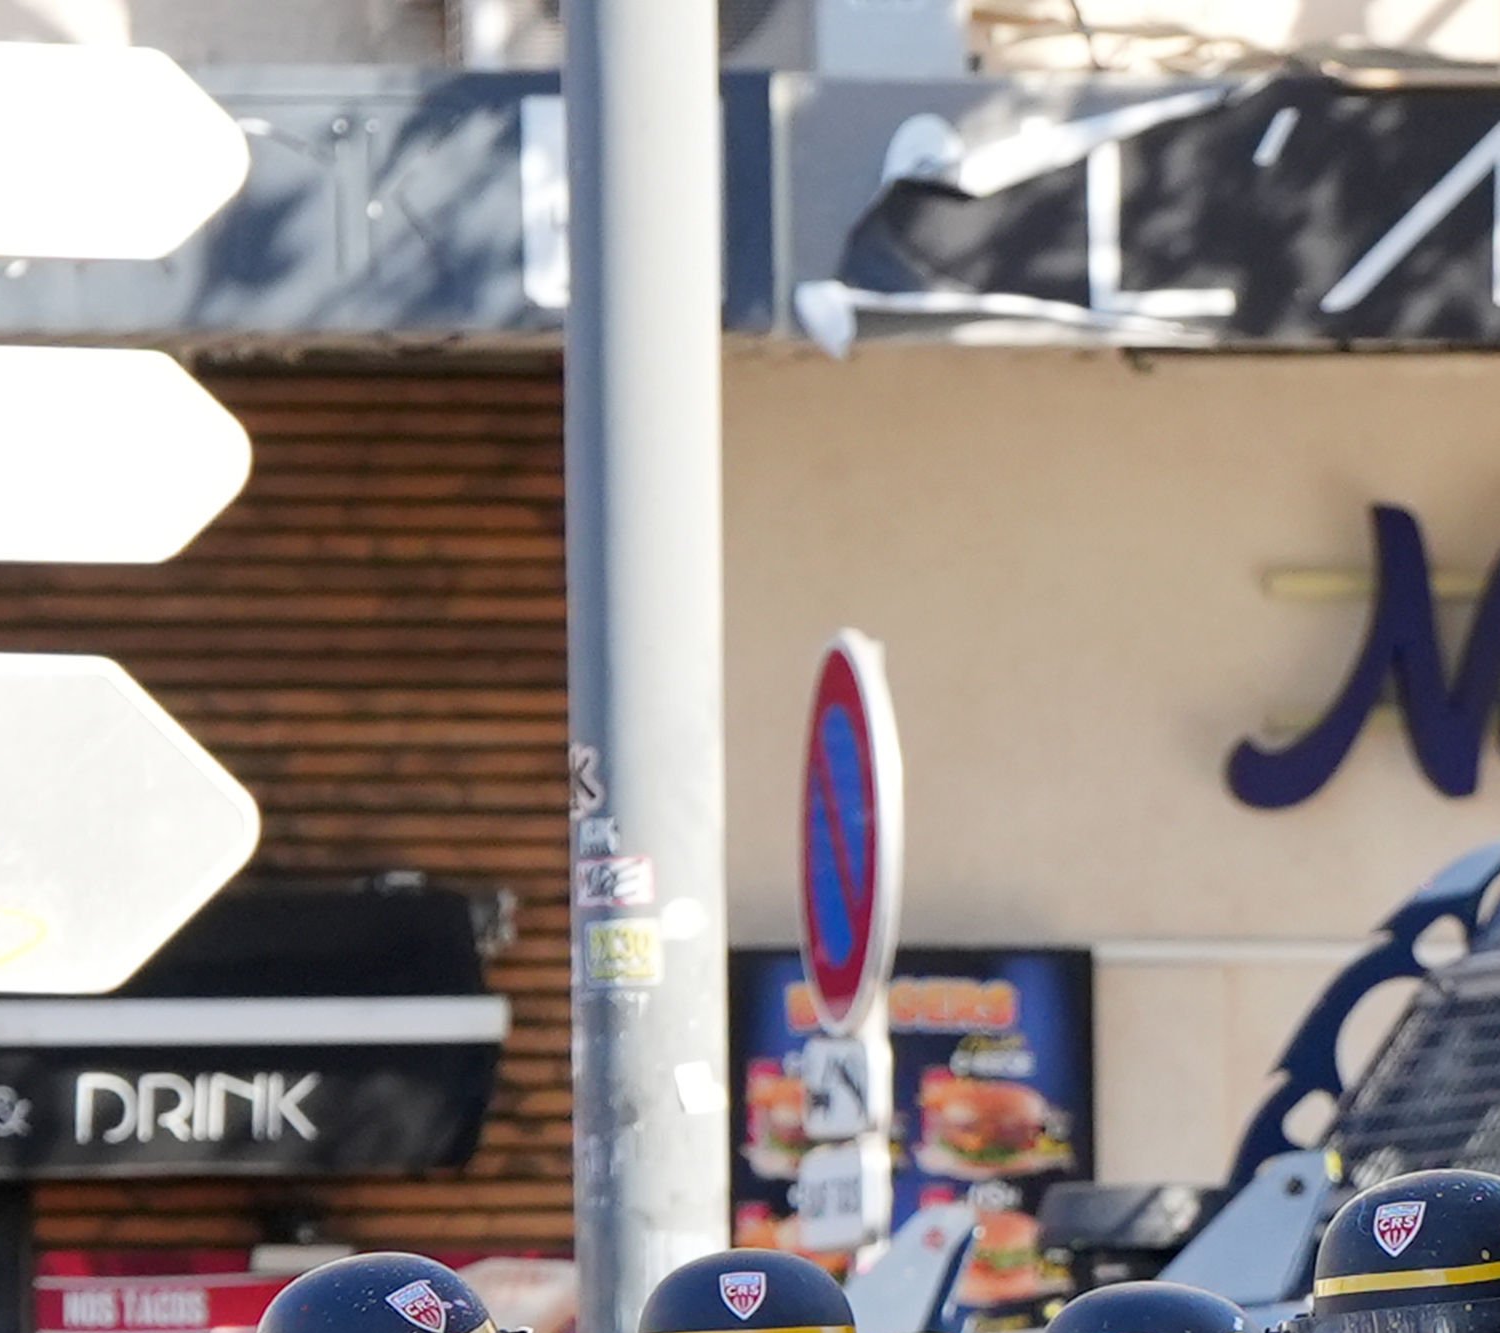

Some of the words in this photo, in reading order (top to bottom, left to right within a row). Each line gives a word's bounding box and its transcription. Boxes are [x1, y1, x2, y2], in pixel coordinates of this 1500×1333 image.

[75, 1070, 323, 1145] DRINK
[1379, 1215, 1416, 1232] CRS
[726, 1284, 760, 1297] CRS
[405, 1296, 438, 1317] CRS
